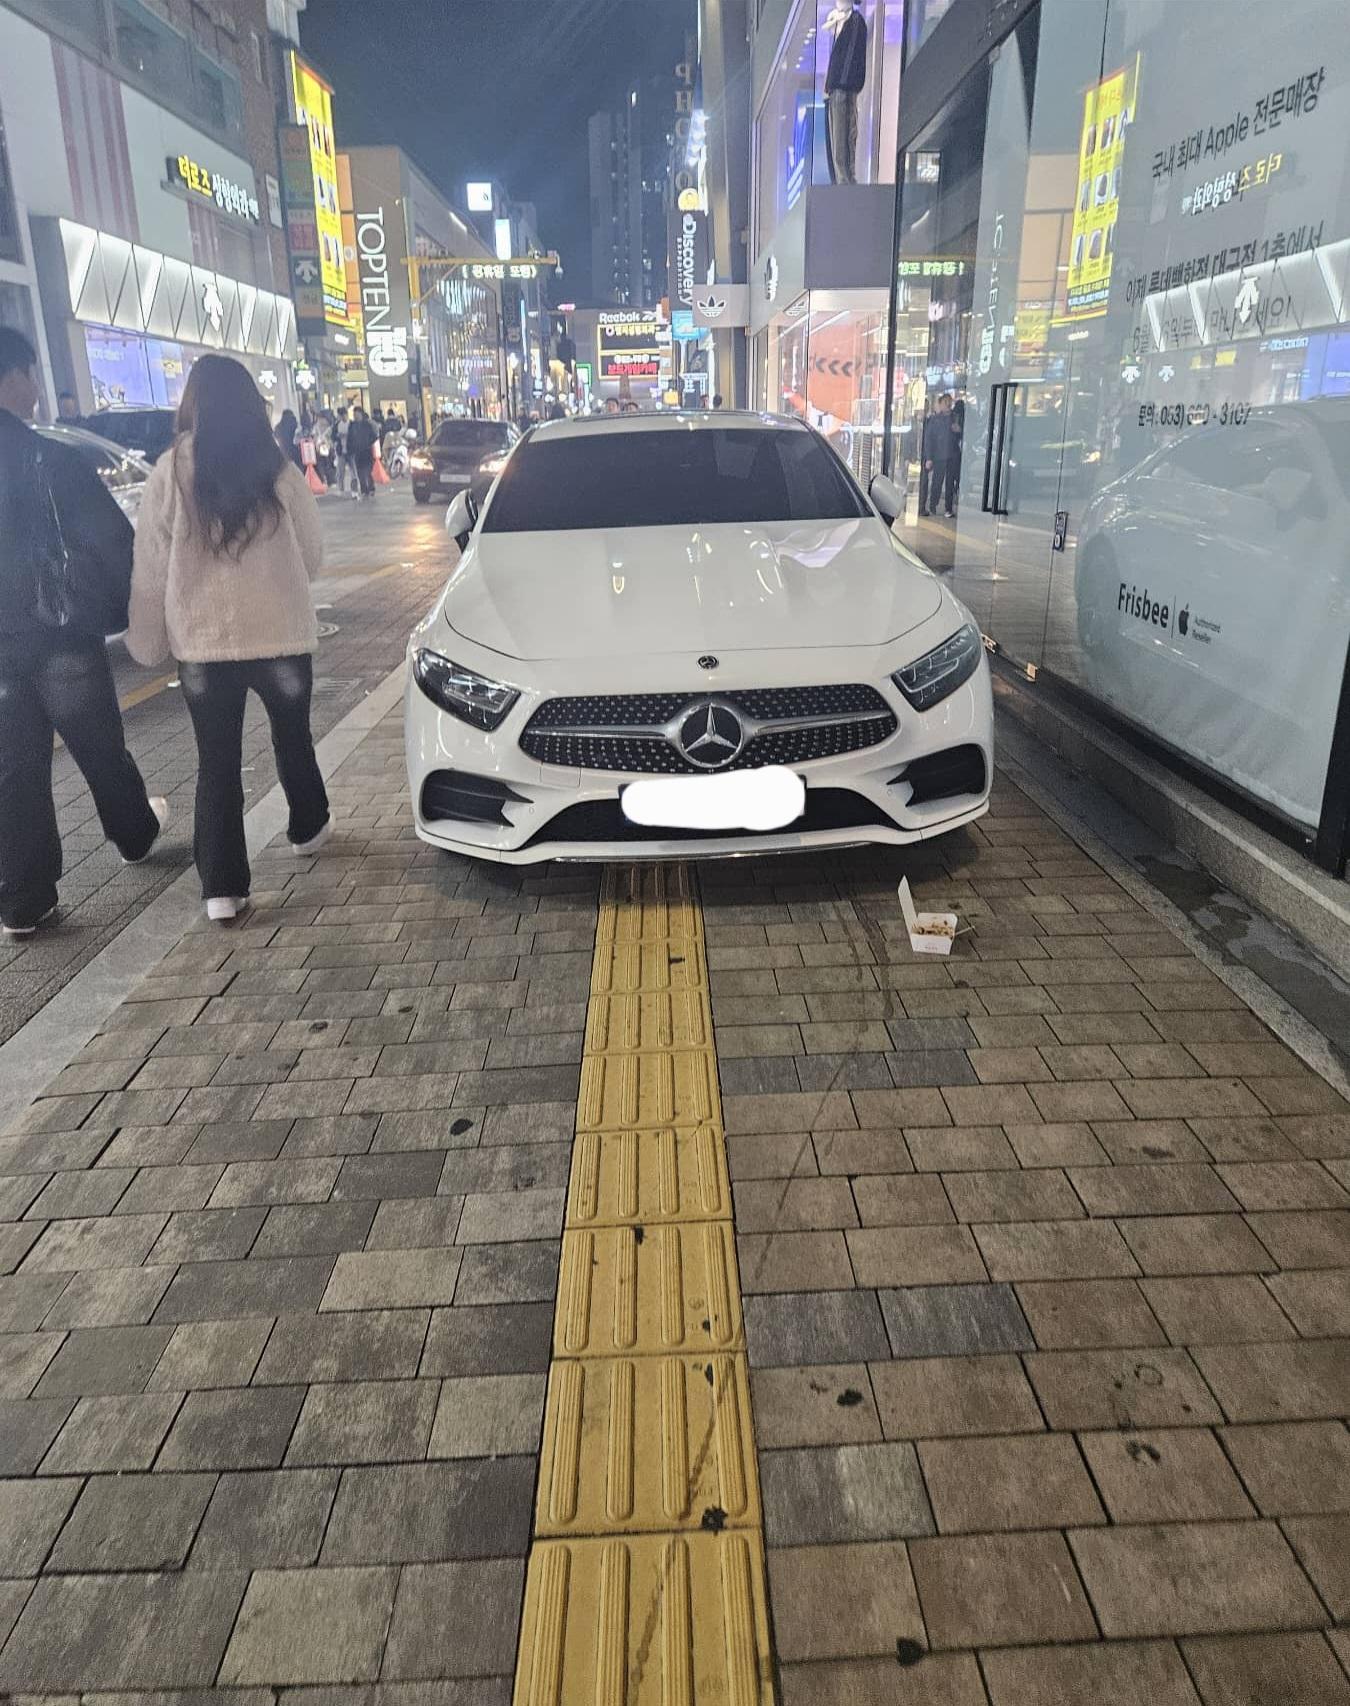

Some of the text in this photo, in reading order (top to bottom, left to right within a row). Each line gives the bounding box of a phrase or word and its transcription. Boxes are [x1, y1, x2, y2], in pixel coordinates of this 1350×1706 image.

[1152, 66, 1325, 180] 국내 최대 Apple 전문매장
[177, 155, 213, 197] 더로즈
[212, 173, 249, 220] 성형외과
[357, 206, 391, 332] TOPTEN
[679, 216, 697, 305] Discovery
[1126, 274, 1147, 308] 이제
[600, 311, 640, 324] Reebok
[1118, 583, 1169, 628] Frisbee
